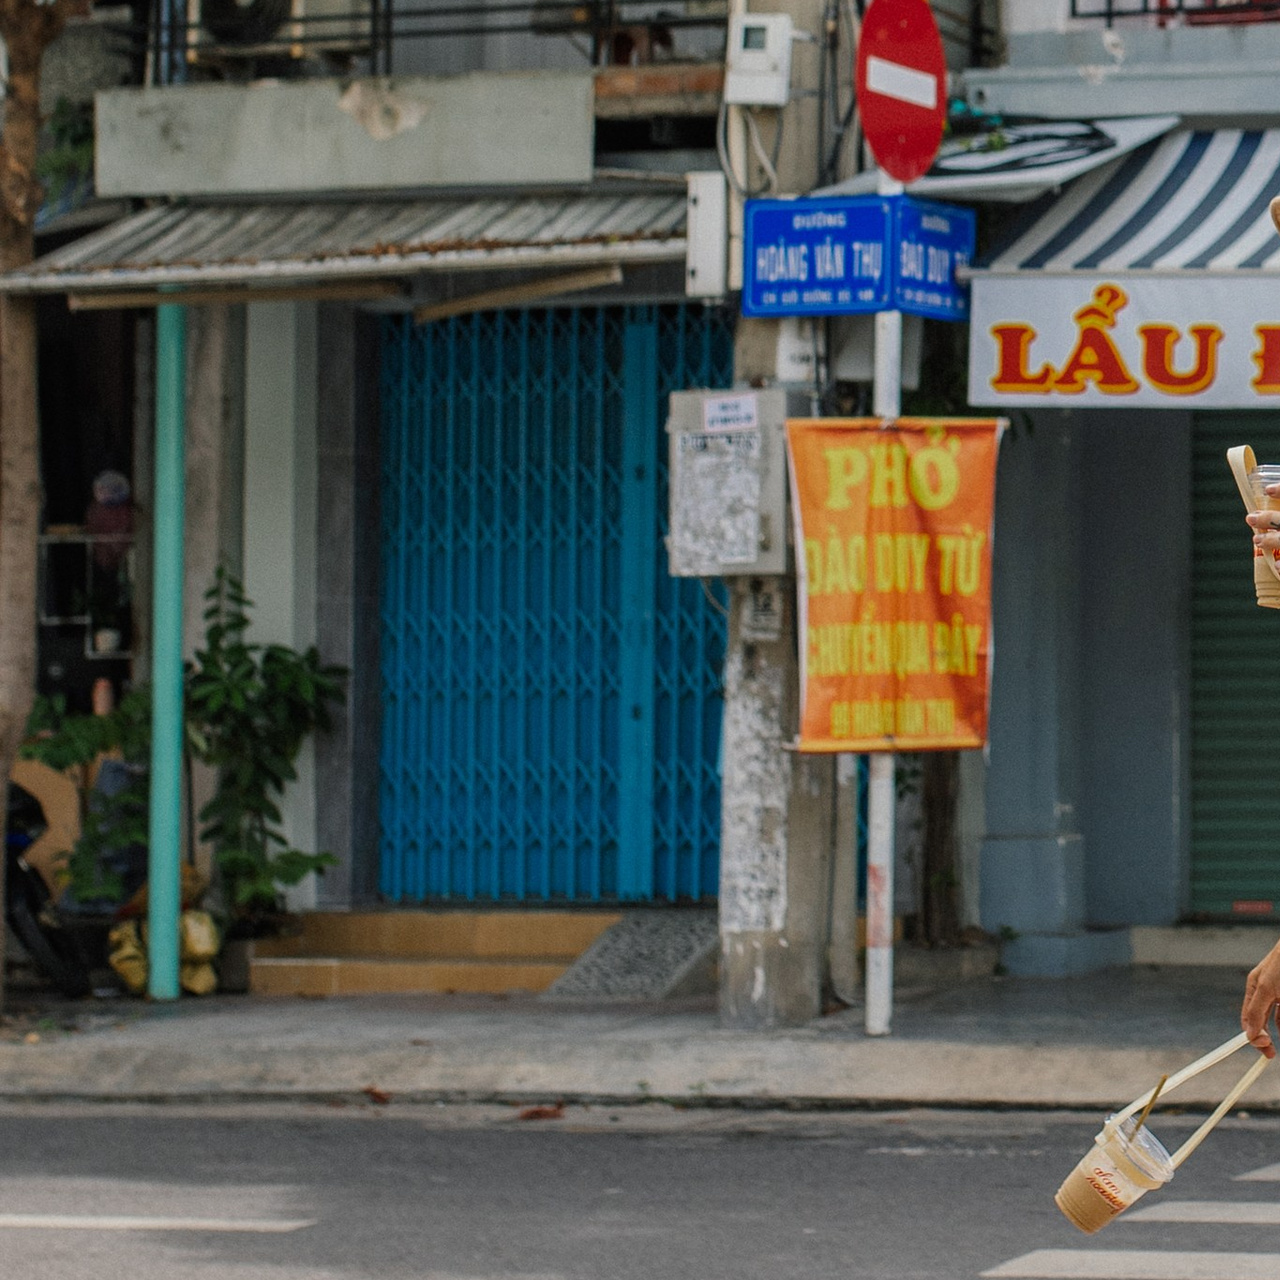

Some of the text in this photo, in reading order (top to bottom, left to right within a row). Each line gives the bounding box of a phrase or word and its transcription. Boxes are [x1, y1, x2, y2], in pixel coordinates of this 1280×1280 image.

[755, 235, 809, 282] HOÀNG
[852, 241, 883, 286] THỤ
[990, 282, 1226, 397] LẨU
[824, 425, 962, 511] PHỞ
[874, 532, 930, 593] DUY
[936, 523, 987, 596] TỪ
